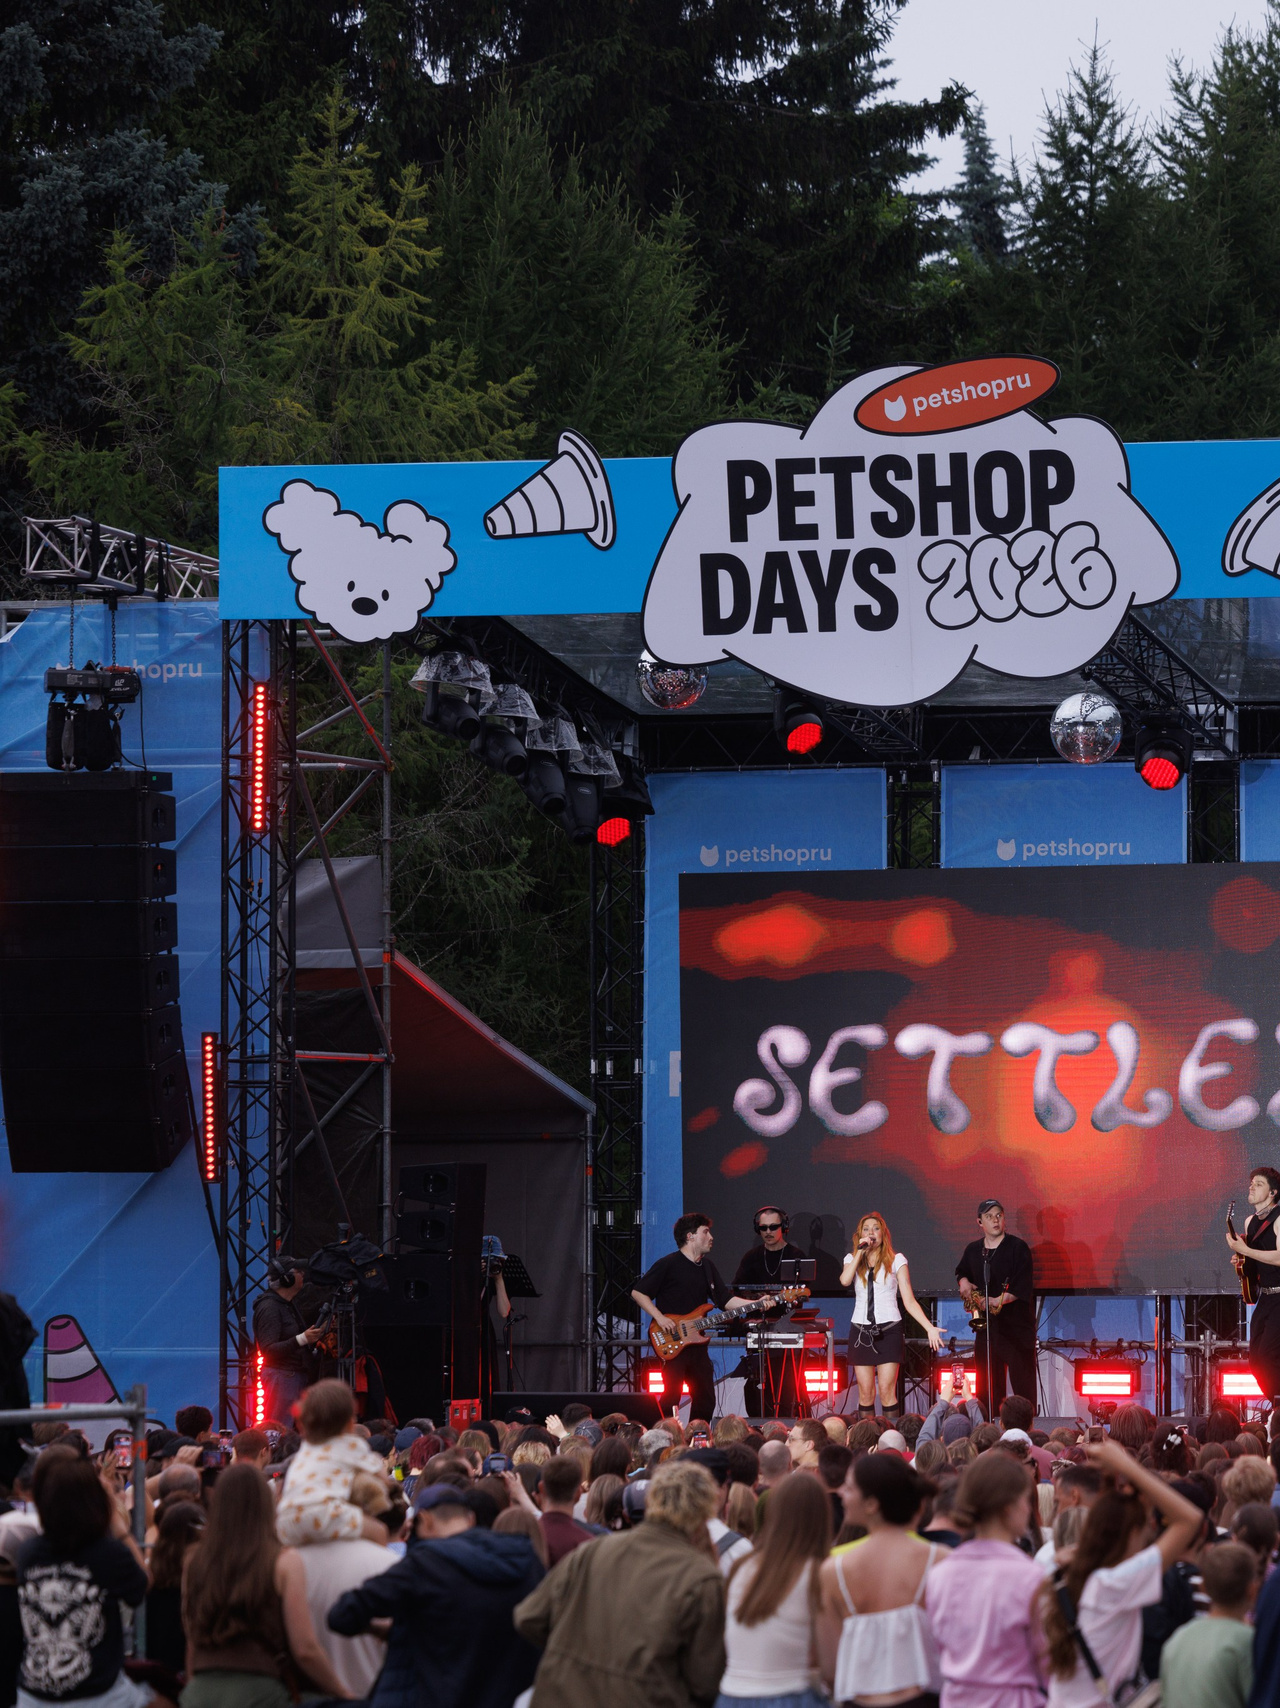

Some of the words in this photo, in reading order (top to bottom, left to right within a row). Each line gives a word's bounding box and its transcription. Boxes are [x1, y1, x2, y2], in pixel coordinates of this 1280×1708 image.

[911, 371, 1032, 416] petshopru
[727, 449, 1075, 542] PETSHOP
[700, 547, 899, 635] DAYS
[918, 521, 1116, 630] 2026
[725, 844, 832, 866] petshopru
[1023, 838, 1131, 860] petshopru
